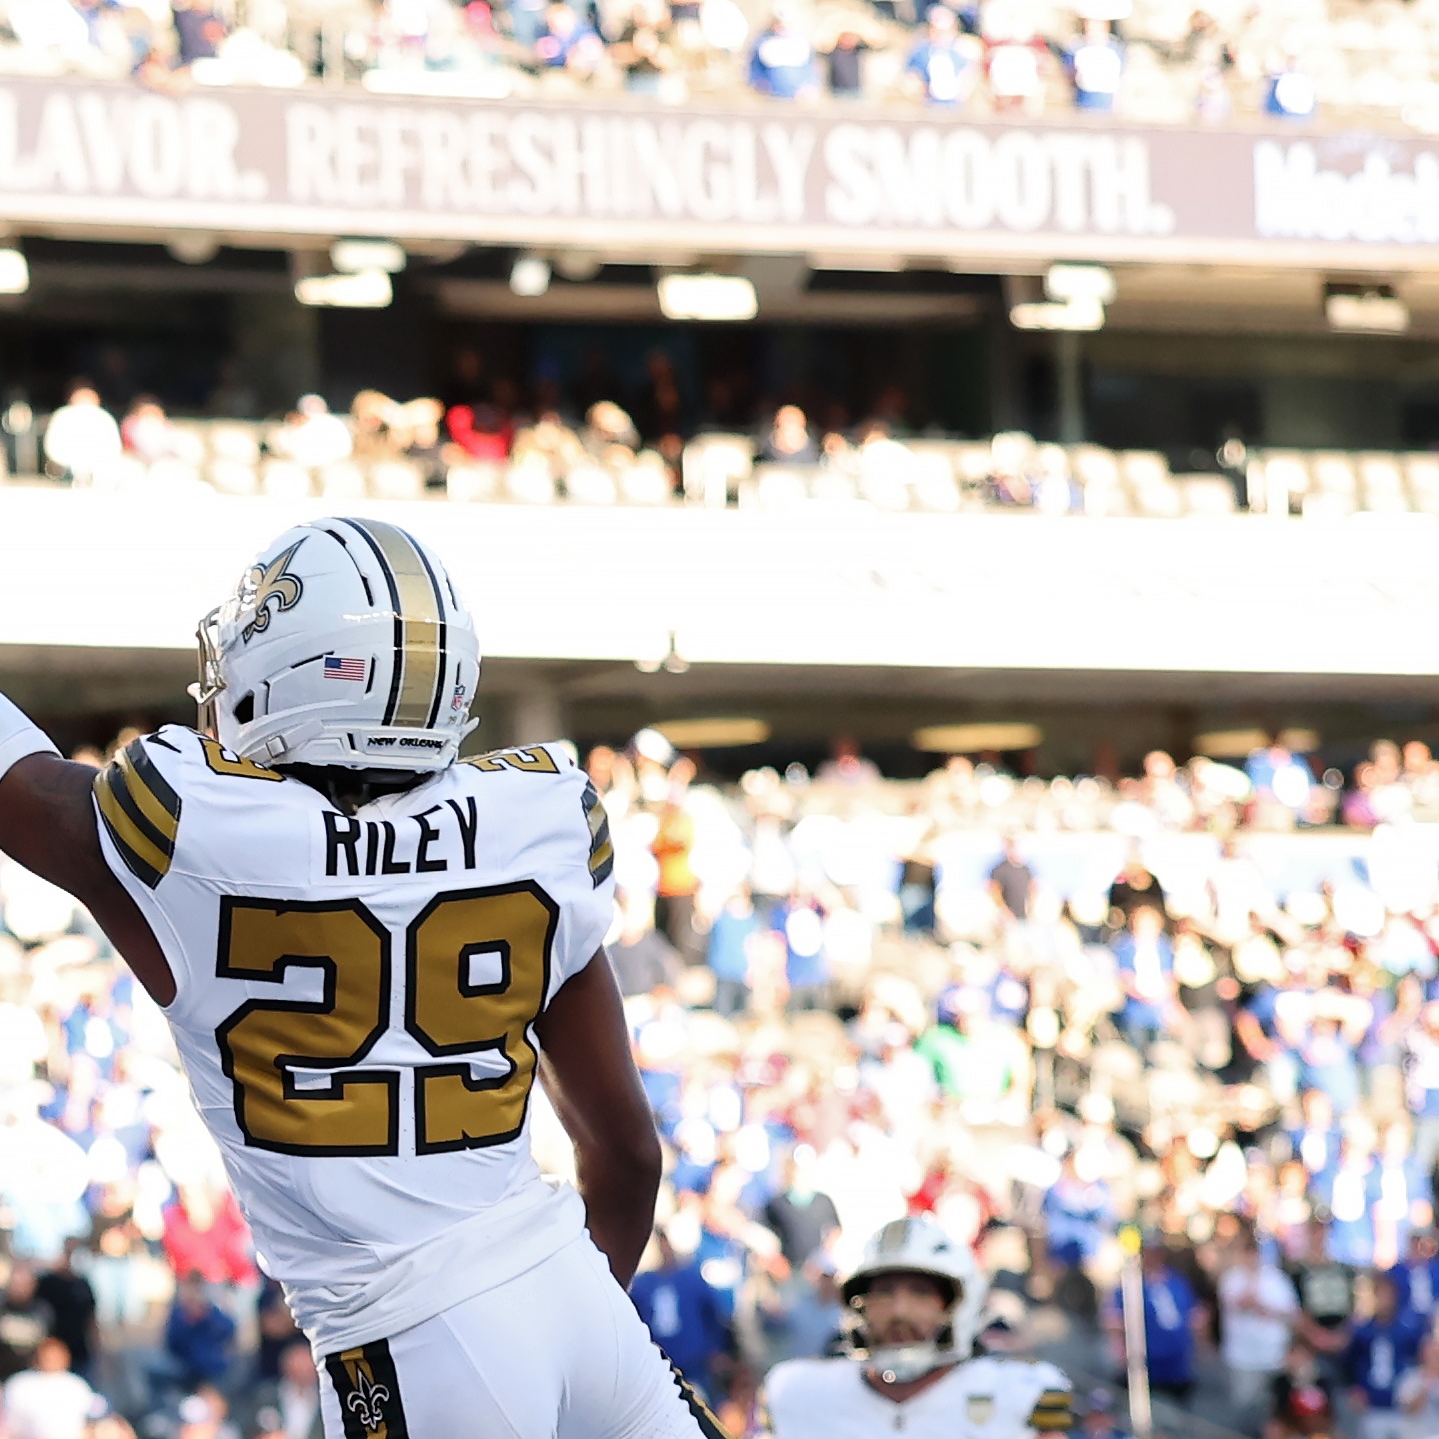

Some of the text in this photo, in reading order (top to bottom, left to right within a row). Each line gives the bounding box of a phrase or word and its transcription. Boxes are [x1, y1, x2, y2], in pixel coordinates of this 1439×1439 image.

[284, 104, 815, 226] REFRESHINGLY
[824, 123, 1175, 238] SMOOTH.
[367, 737, 445, 749] NEW ORLEANS
[322, 795, 479, 876] RILEY
[215, 879, 560, 1157] 29
